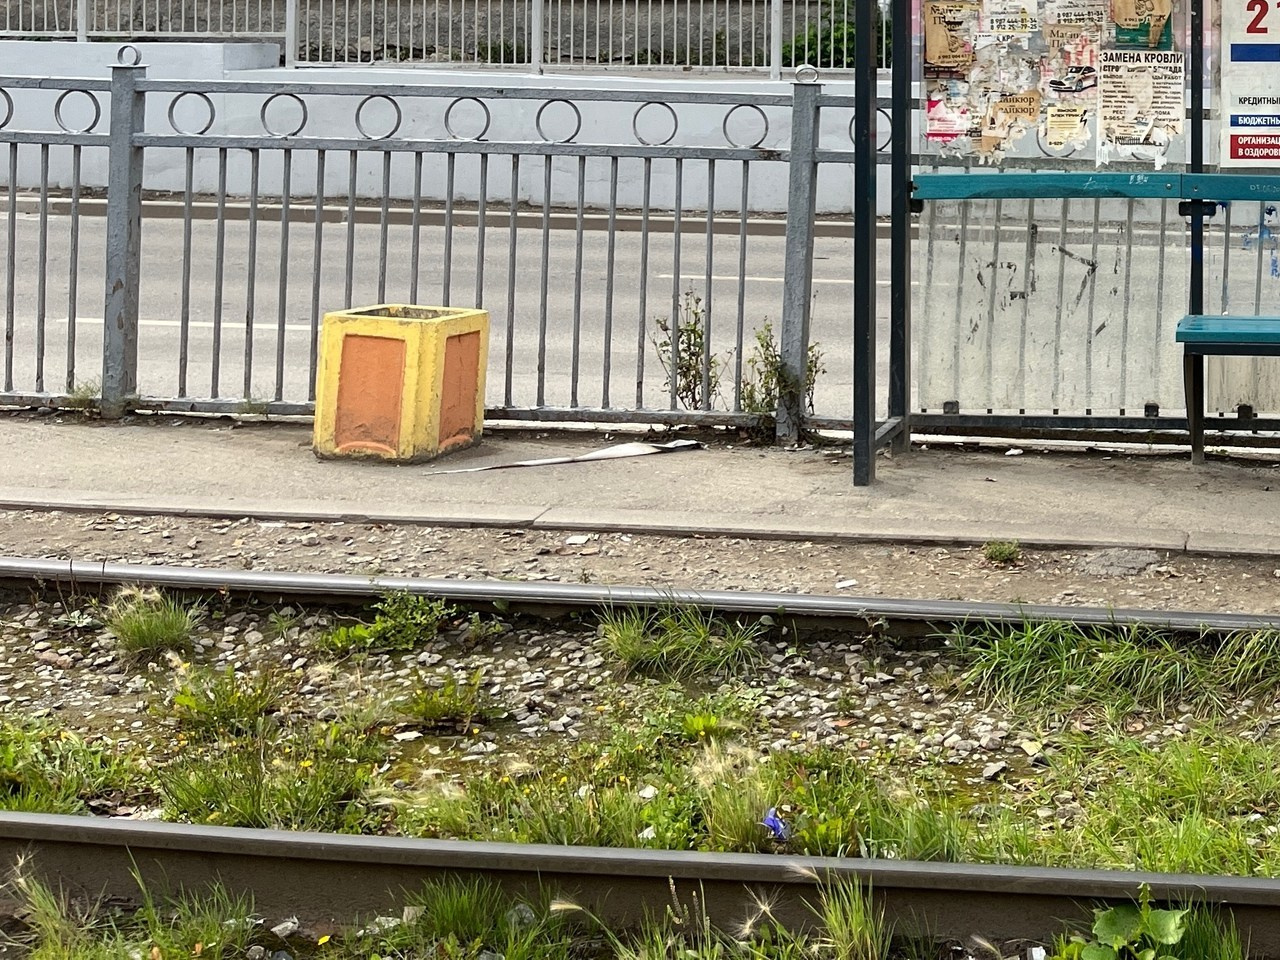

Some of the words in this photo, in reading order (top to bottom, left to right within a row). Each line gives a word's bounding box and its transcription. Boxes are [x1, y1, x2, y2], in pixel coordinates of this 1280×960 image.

[1102, 52, 1142, 62] ЗАМЕНА
[1144, 53, 1183, 64] КРОВЛИ
[1001, 96, 1035, 106] аникюр
[1001, 106, 1035, 116] едикюр
[1238, 148, 1244, 156] В
